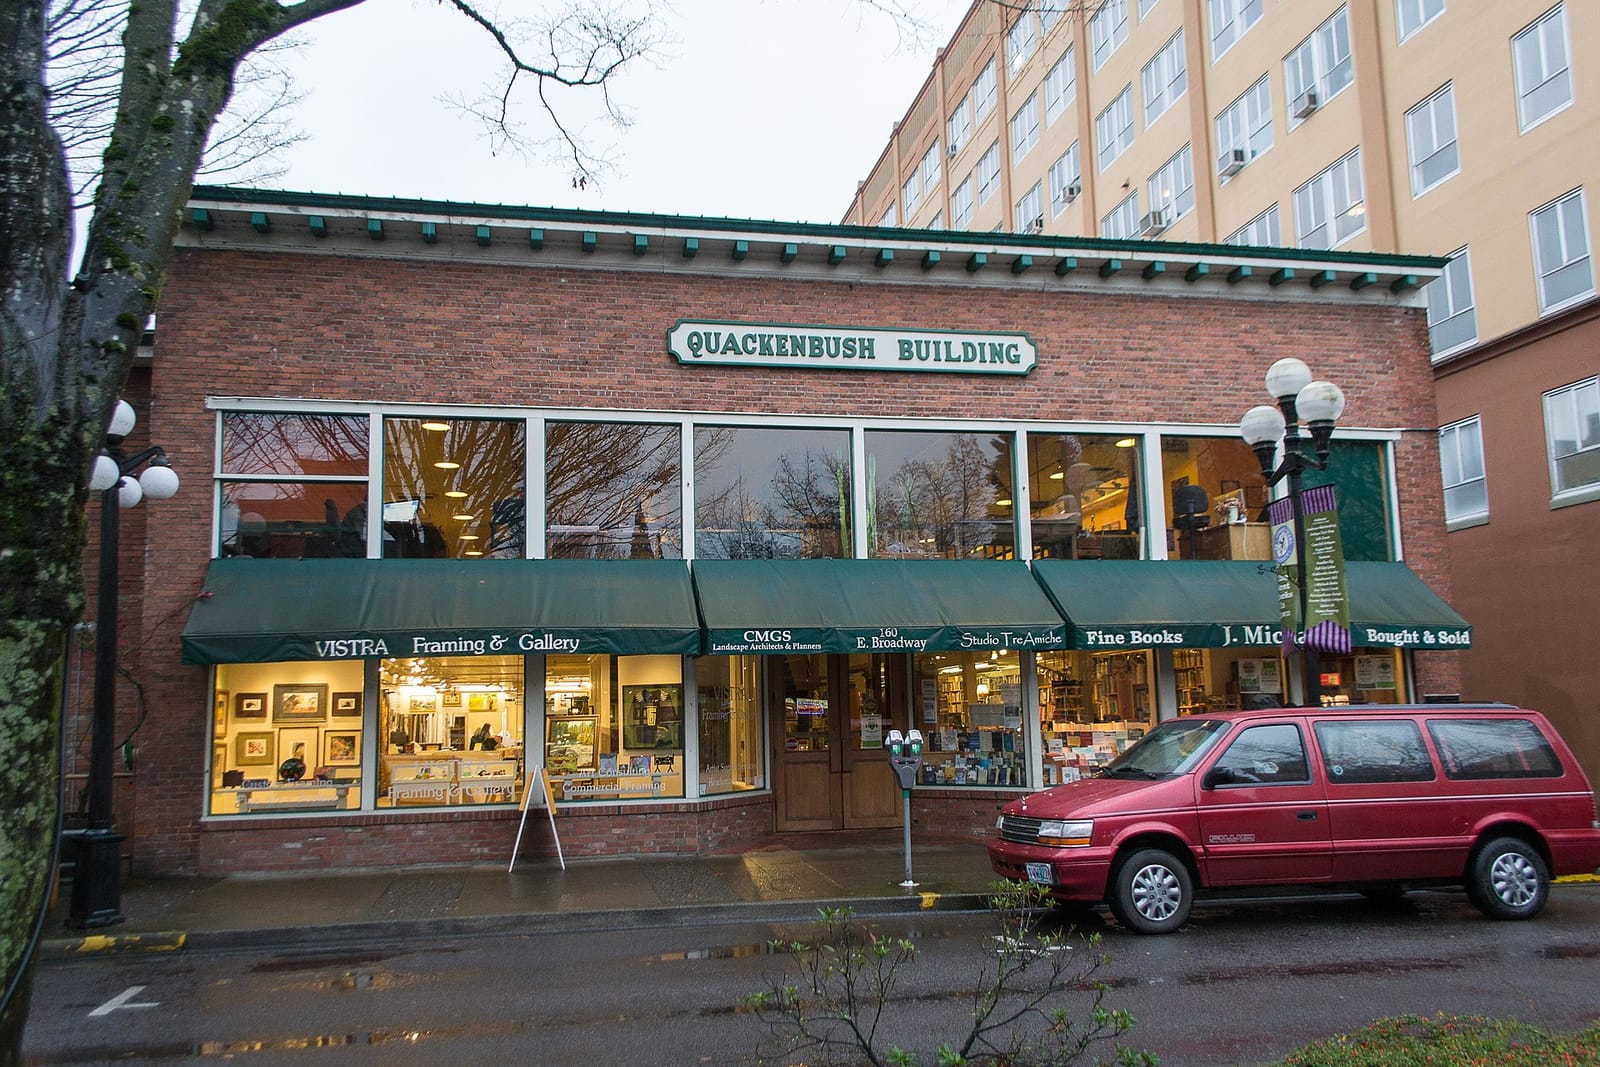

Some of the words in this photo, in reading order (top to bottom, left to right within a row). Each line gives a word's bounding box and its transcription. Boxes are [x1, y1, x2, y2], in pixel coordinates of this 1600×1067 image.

[687, 331, 876, 360] QUACKENBUSH
[898, 338, 1021, 364] BUILDING
[743, 630, 792, 643] CMGS
[879, 628, 898, 638] 160
[960, 632, 999, 648] Studio
[1086, 631, 1125, 645] Fine
[1129, 630, 1183, 644] Books
[1222, 625, 1238, 647] J.
[1367, 628, 1420, 645] Bought
[1423, 631, 1436, 644] &
[1438, 630, 1470, 645] Sold
[315, 638, 389, 657] VISTRA
[412, 636, 485, 655] Framing
[490, 634, 509, 650] &
[518, 633, 580, 652] Gallery
[713, 643, 749, 652] Landscape
[749, 642, 784, 650] Architects
[785, 642, 792, 650] &
[792, 642, 822, 650] Planners
[857, 637, 869, 648] E.
[872, 636, 927, 651] Broadway
[387, 786, 444, 799] Framing
[562, 780, 622, 793] Commercial
